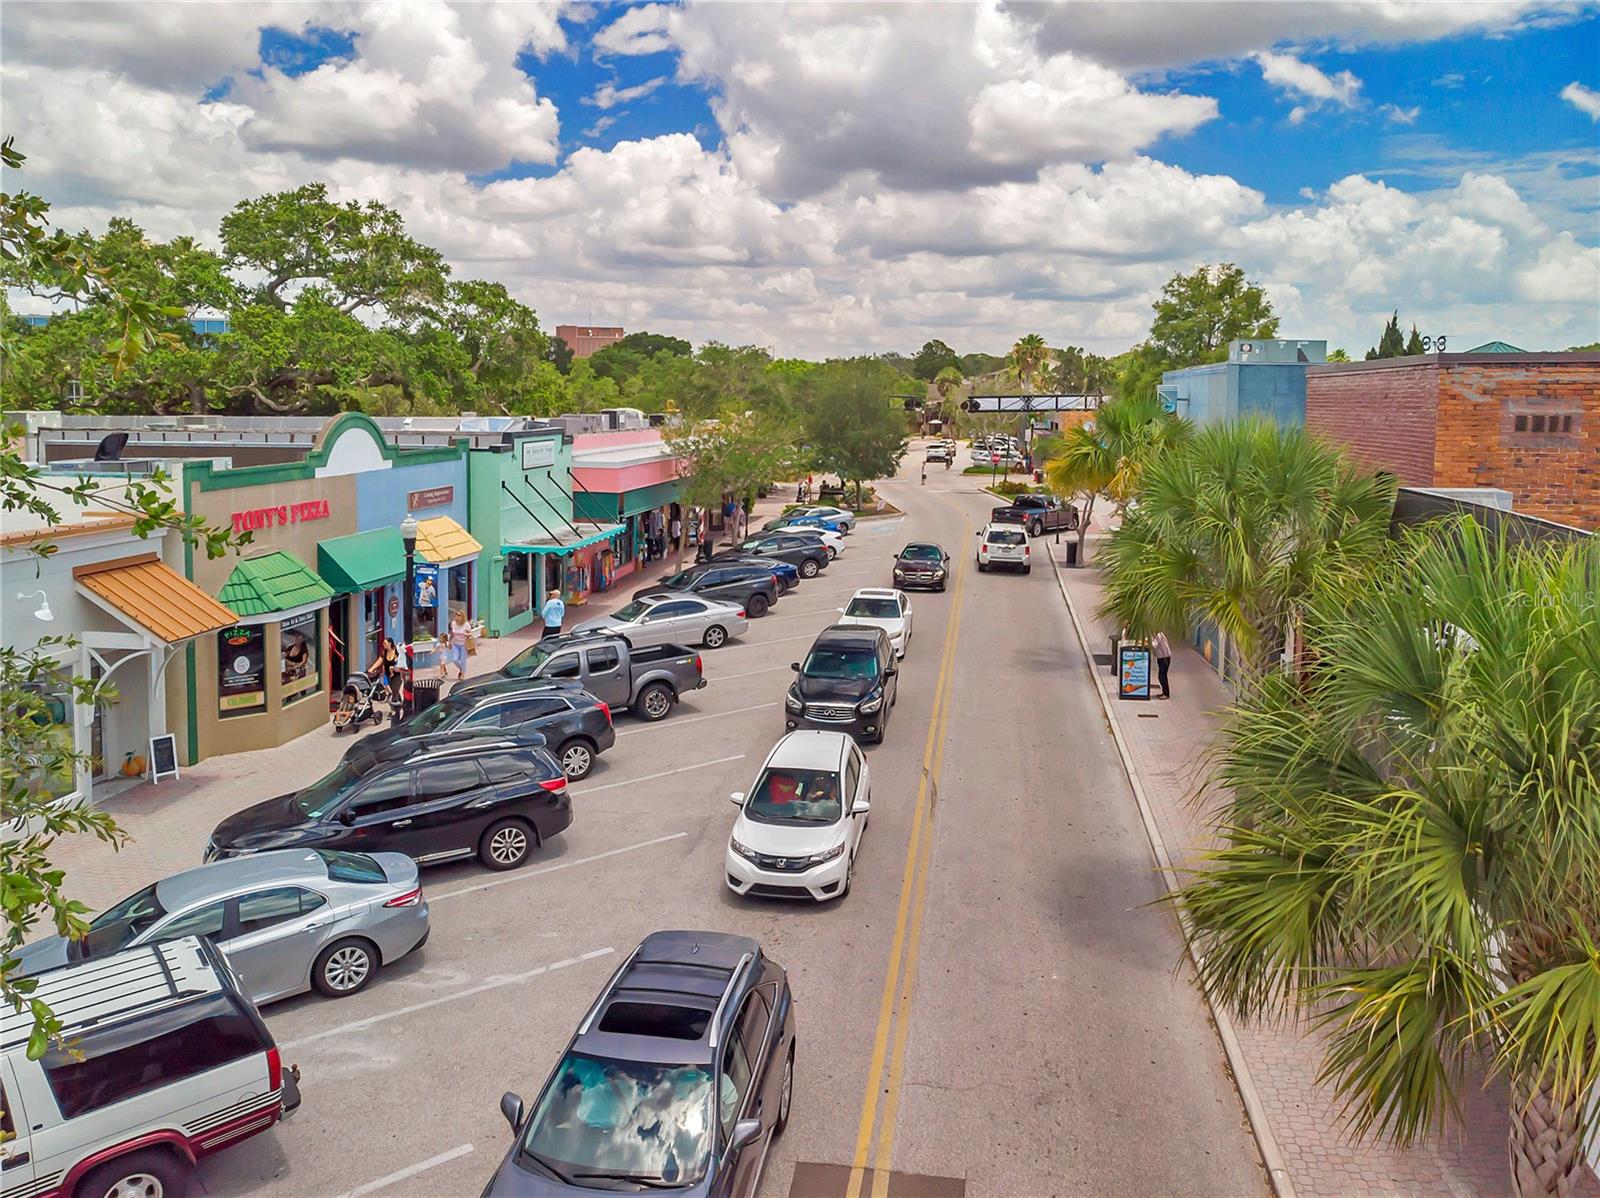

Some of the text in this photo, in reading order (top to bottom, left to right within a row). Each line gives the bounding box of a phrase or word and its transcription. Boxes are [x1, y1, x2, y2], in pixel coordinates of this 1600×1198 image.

[231, 499, 330, 532] TONY'S PIZZA
[223, 629, 250, 639] PIZZA
